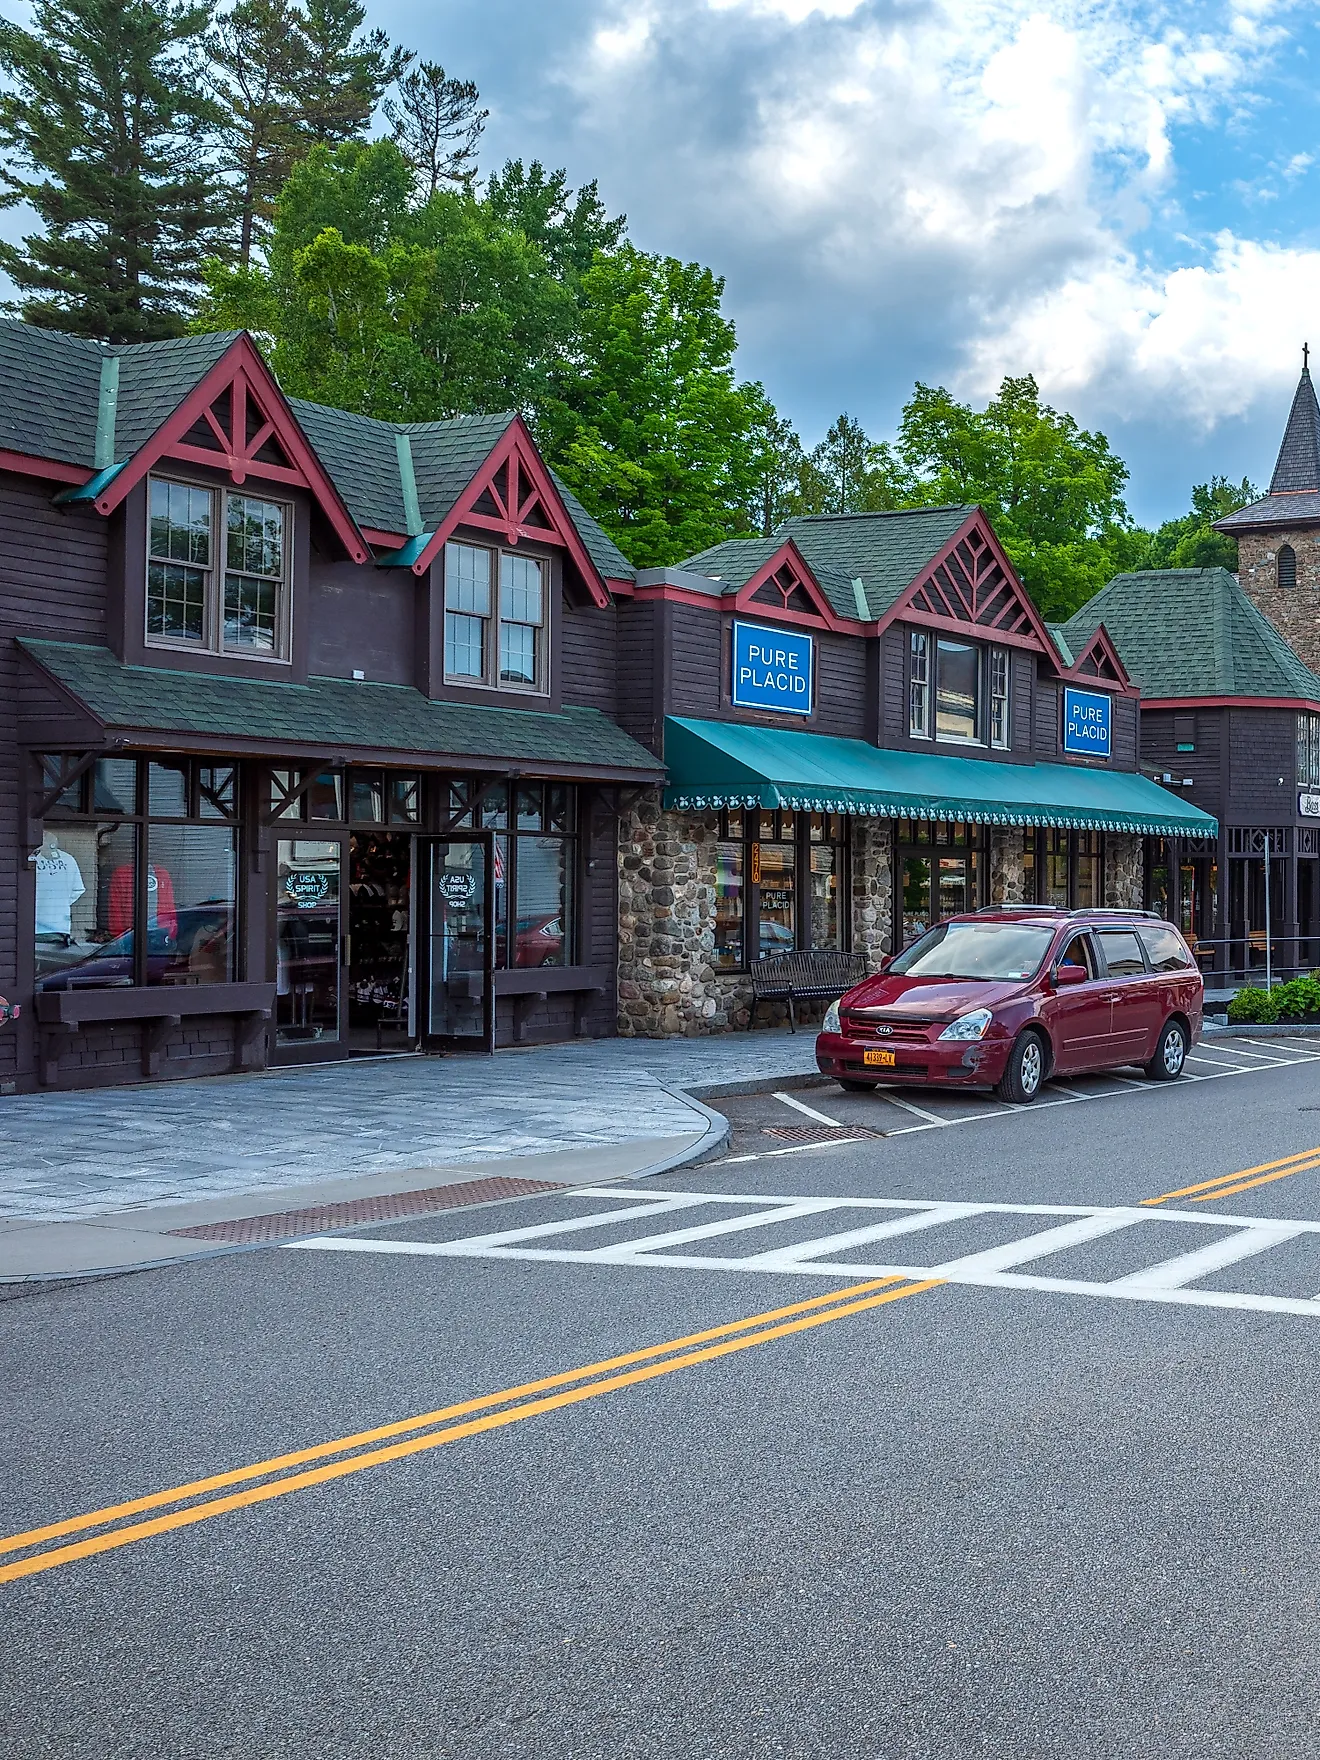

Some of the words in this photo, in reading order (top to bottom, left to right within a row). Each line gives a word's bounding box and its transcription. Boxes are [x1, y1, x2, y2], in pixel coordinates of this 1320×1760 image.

[749, 644, 799, 670] PURE
[740, 666, 806, 693] PLACID
[1073, 704, 1103, 723] PURE
[1068, 721, 1107, 741] PLACID
[299, 875, 316, 883] USA
[295, 884, 320, 892] SPIRIT
[765, 891, 787, 900] PURE
[297, 901, 317, 909] SHOP
[762, 901, 790, 909] PLACID
